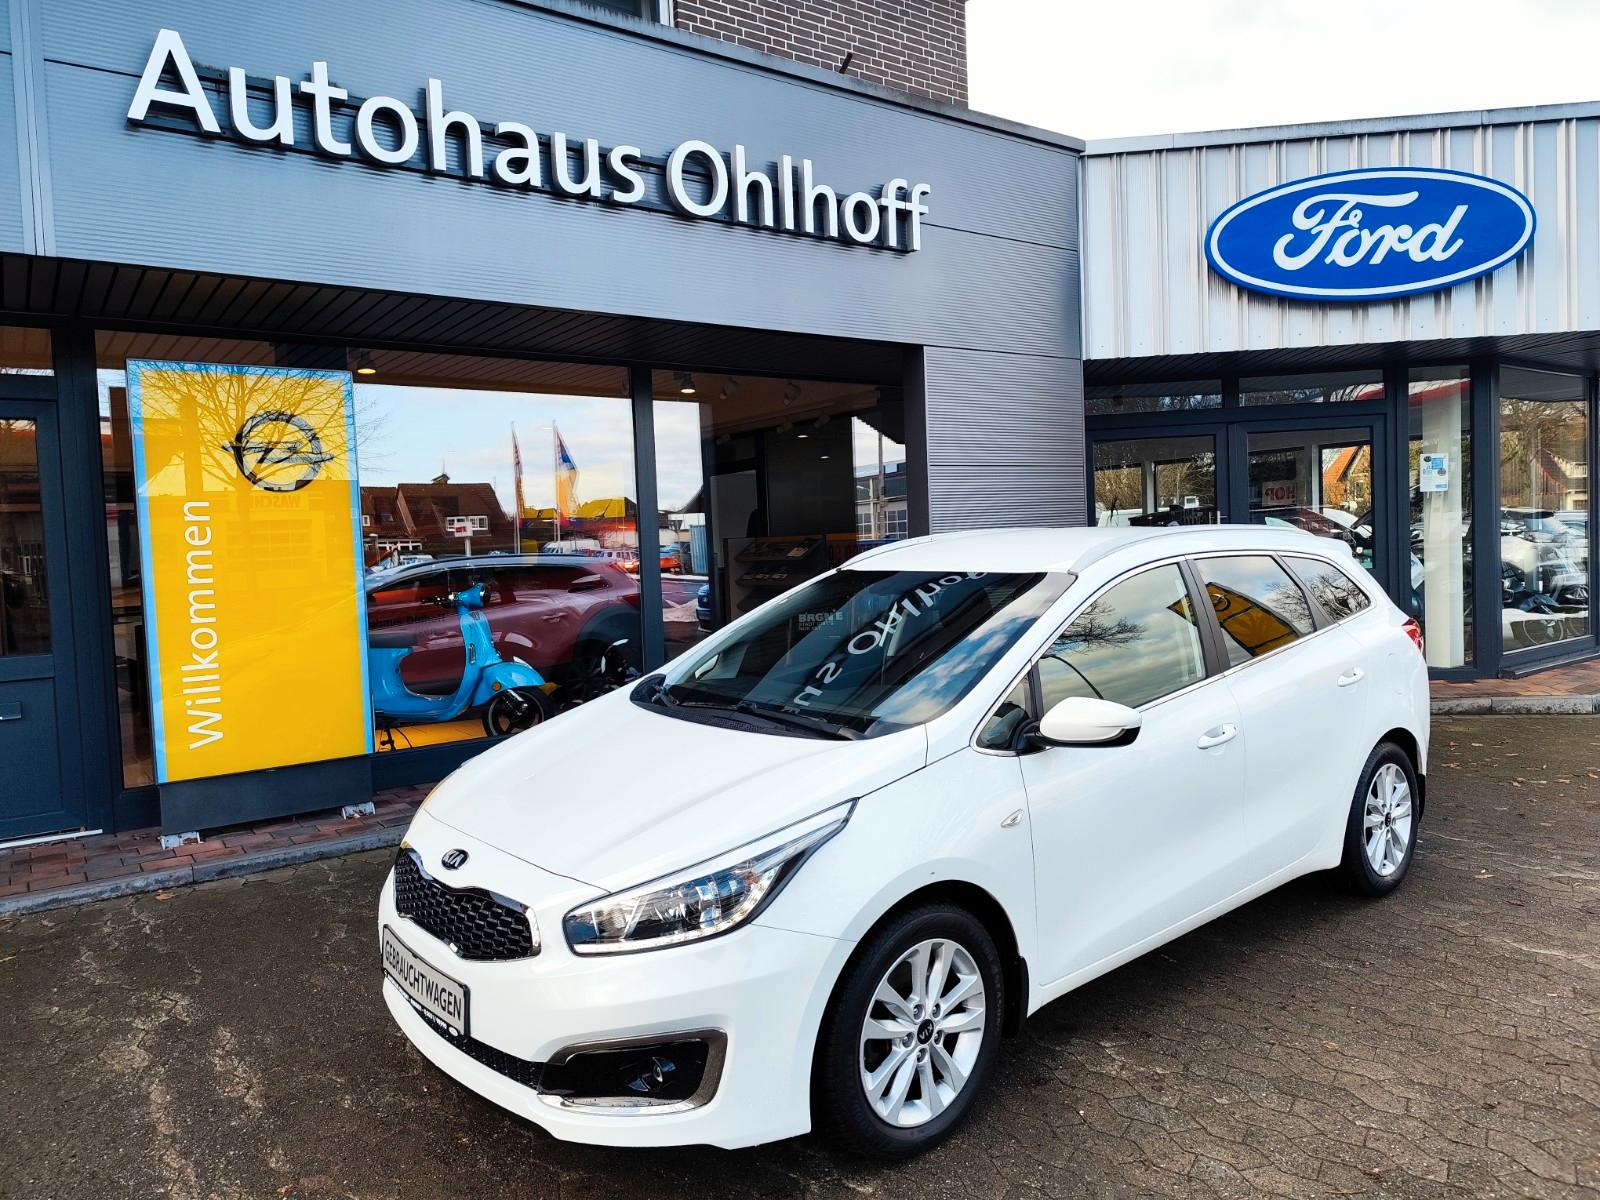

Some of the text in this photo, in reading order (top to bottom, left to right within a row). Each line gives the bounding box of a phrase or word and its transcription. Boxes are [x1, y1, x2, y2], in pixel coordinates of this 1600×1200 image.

[127, 29, 931, 251] Autohaus Ohlhoff
[1272, 190, 1469, 271] Ford
[181, 500, 224, 751] Willkommen
[442, 849, 465, 868] KIA
[385, 940, 462, 1021] GEBRAUCHTWAGEN
